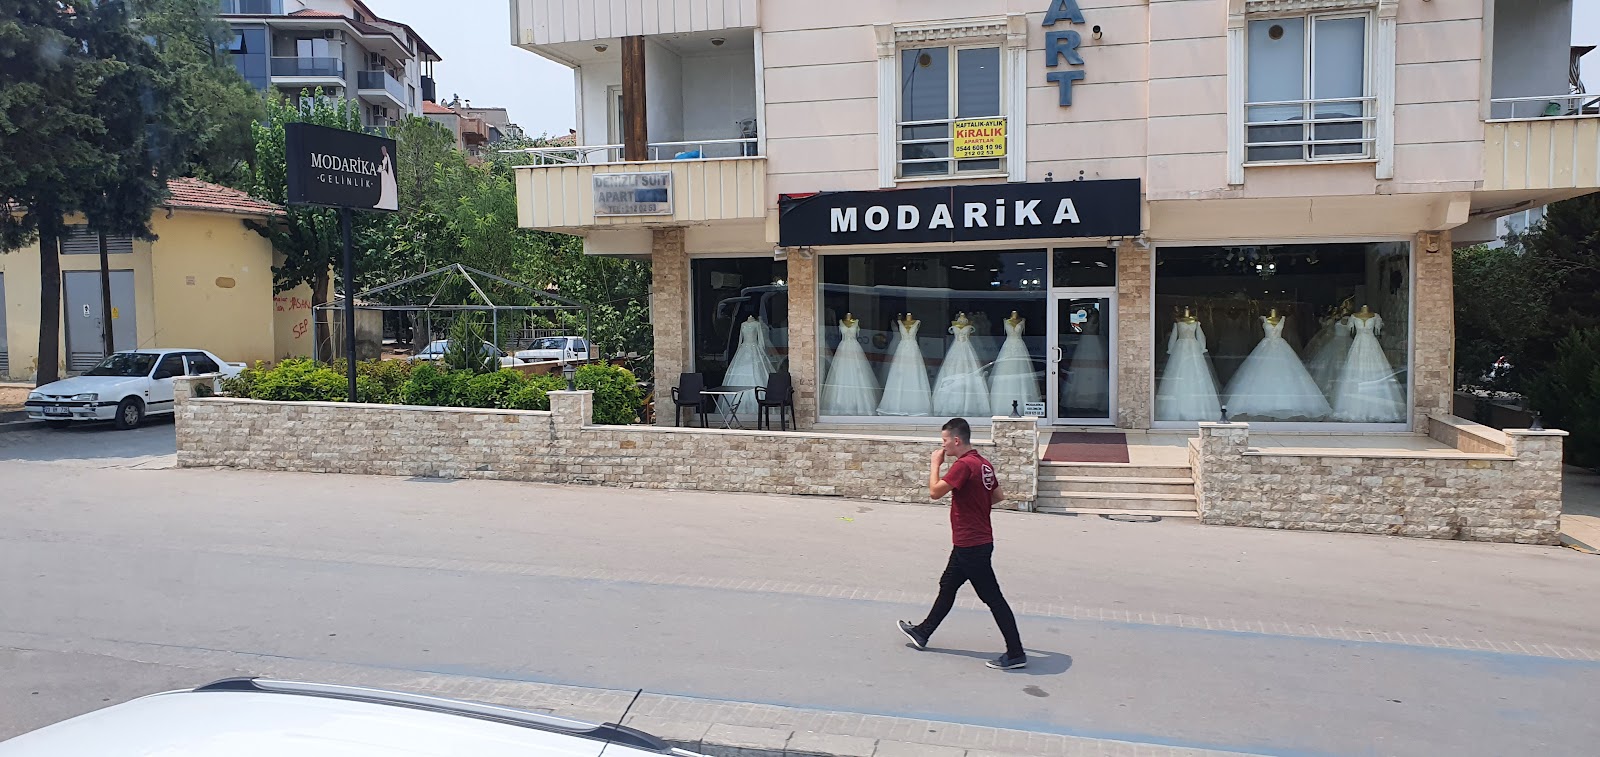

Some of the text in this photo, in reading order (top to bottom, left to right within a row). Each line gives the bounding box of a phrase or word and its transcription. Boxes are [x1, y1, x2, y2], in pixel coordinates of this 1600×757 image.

[310, 152, 378, 176] MODARİKA
[319, 173, 371, 188] GELİNLİK
[598, 191, 634, 203] APART
